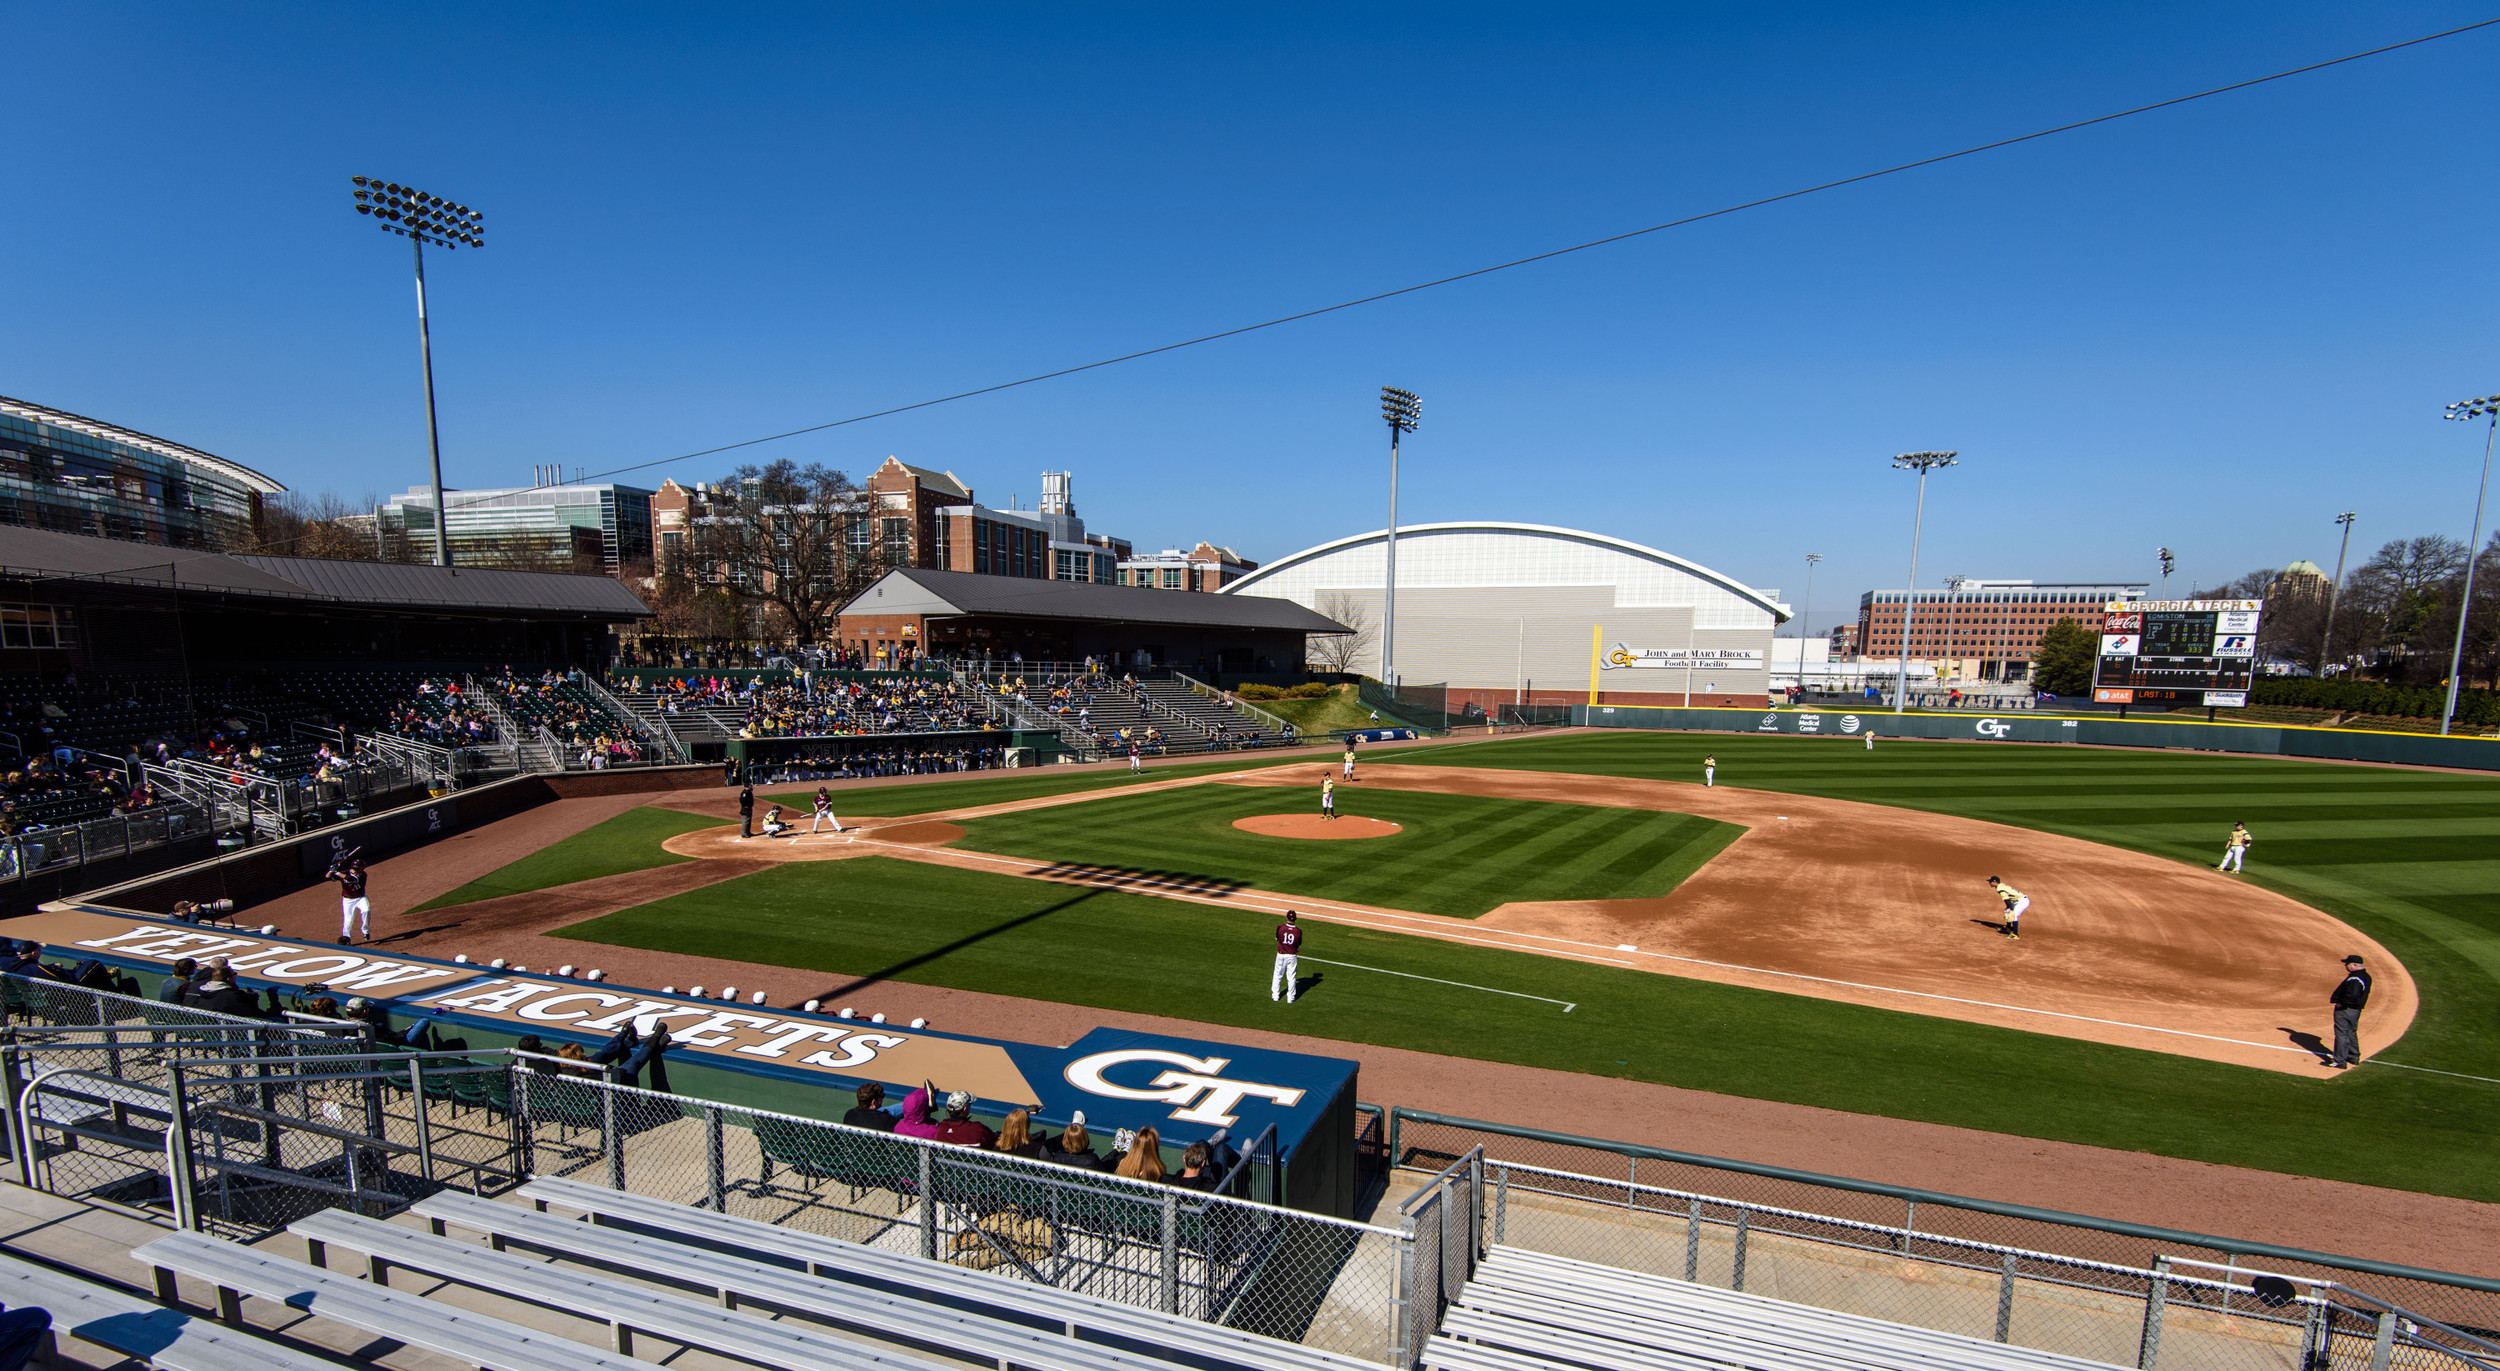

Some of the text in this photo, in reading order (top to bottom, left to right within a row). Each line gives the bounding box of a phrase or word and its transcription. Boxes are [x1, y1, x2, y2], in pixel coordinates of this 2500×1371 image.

[2128, 601, 2196, 611] GEORGIA
[2200, 600, 2242, 611] TECH
[1610, 650, 1637, 667] GT
[1645, 650, 1668, 658] JOHN
[1691, 650, 1717, 658] MARY
[1719, 650, 1751, 658] BROCK
[1699, 660, 1729, 668] Facility
[2138, 691, 2163, 699] LAST:
[1976, 719, 2011, 738] GT
[1283, 932, 1295, 945] 19
[72, 925, 908, 1068] YELLOW JACKETS
[1063, 1049, 1307, 1128] GT
